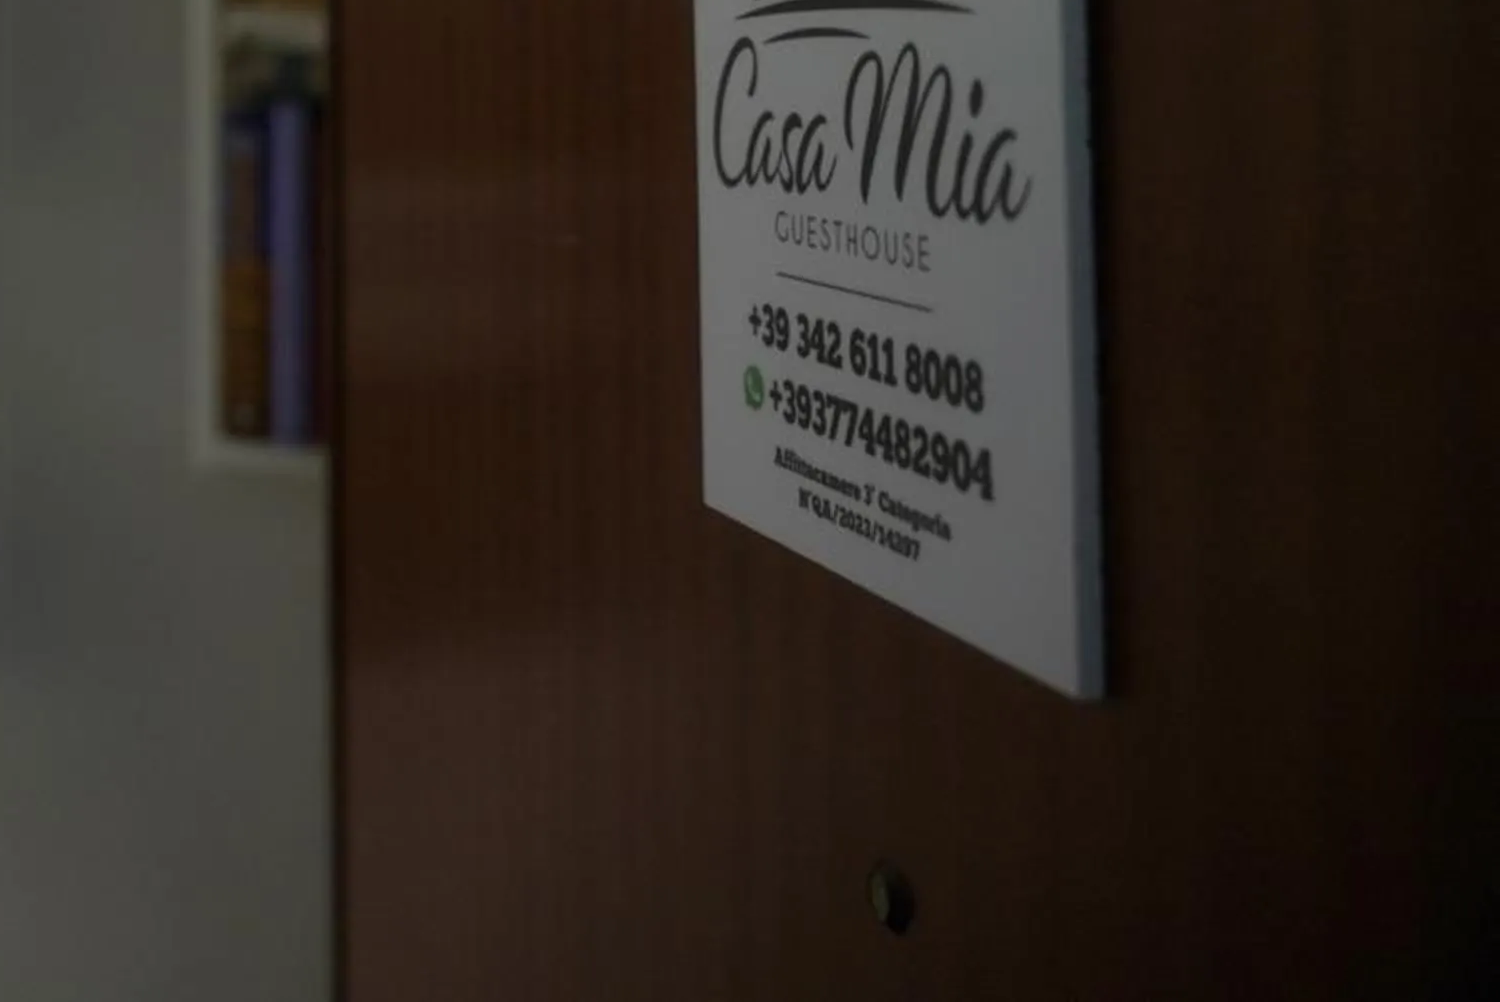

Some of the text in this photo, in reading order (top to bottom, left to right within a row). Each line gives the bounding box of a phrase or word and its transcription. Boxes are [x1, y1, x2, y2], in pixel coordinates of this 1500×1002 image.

[713, 36, 1034, 226] Casa Mia
[775, 210, 932, 273] GUESTHOUSE
[748, 302, 985, 415] +39 342 611 8008
[769, 378, 995, 502] +393774482904
[878, 490, 953, 542] Categoria
